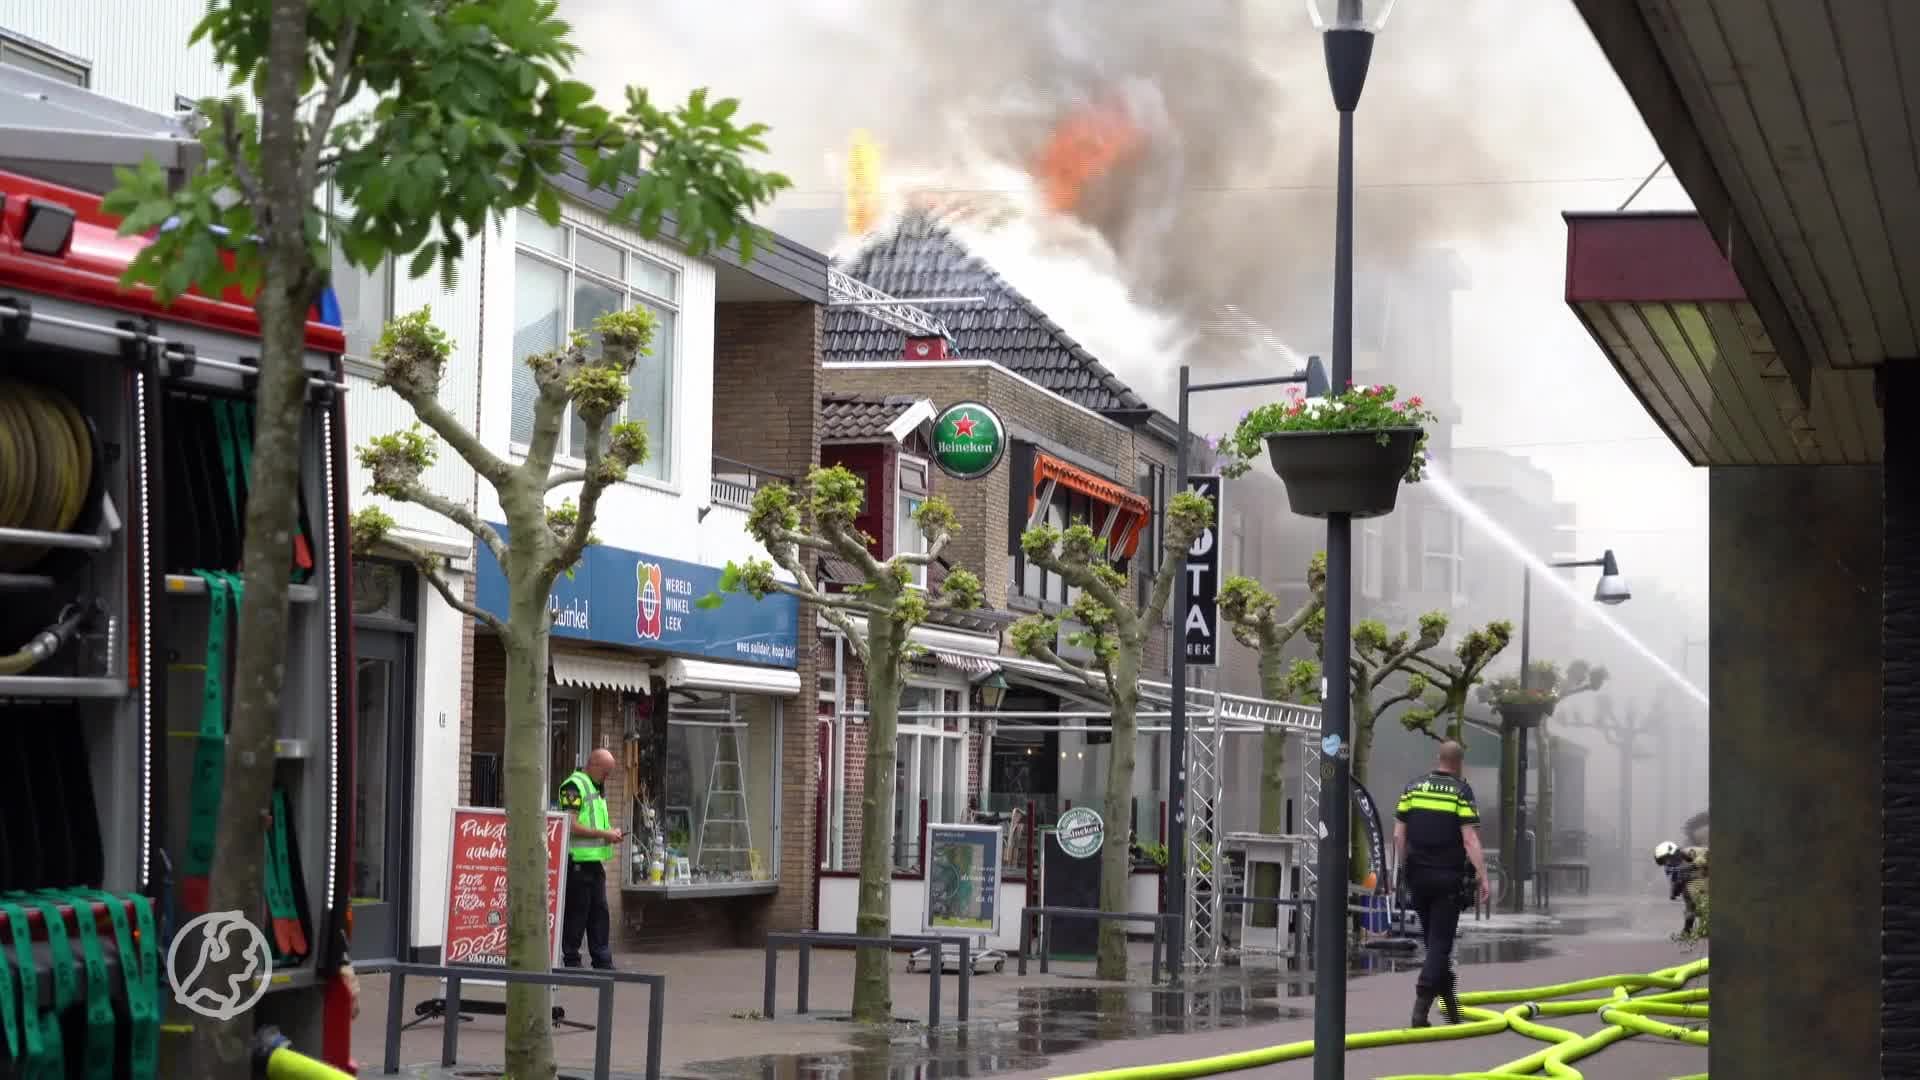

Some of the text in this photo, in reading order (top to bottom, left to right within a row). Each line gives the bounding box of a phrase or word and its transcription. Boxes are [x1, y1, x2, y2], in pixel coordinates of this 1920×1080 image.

[938, 441, 993, 453] Heineken
[665, 577, 692, 595] WERELD
[665, 596, 690, 614] WINKEL
[665, 615, 682, 632] LEEK
[1187, 643, 1211, 656] EEK
[487, 955, 506, 965] DON
